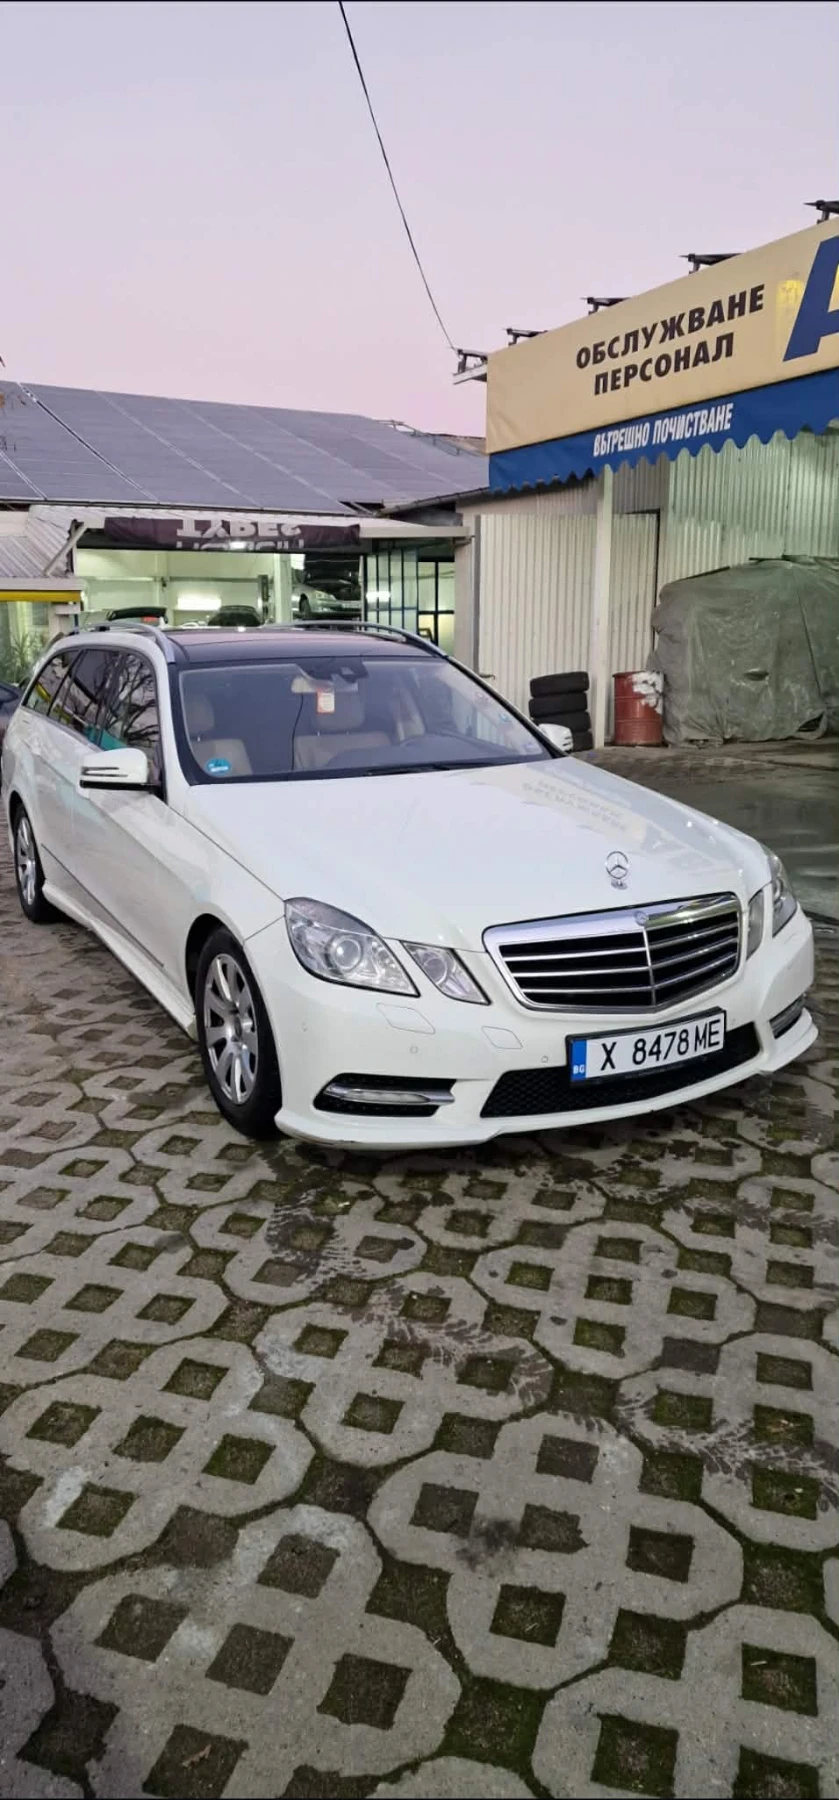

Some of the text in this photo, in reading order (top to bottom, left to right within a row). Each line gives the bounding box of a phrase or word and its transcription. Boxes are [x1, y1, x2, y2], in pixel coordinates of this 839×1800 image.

[576, 284, 765, 369] ОБСЛУЖВАНЕ
[594, 332, 734, 396] ПЕРСОНАЛ
[652, 402, 734, 445] ПОЧИСТВАНЕ
[573, 1064, 586, 1075] BG
[600, 1019, 721, 1071] X 8478 ME
